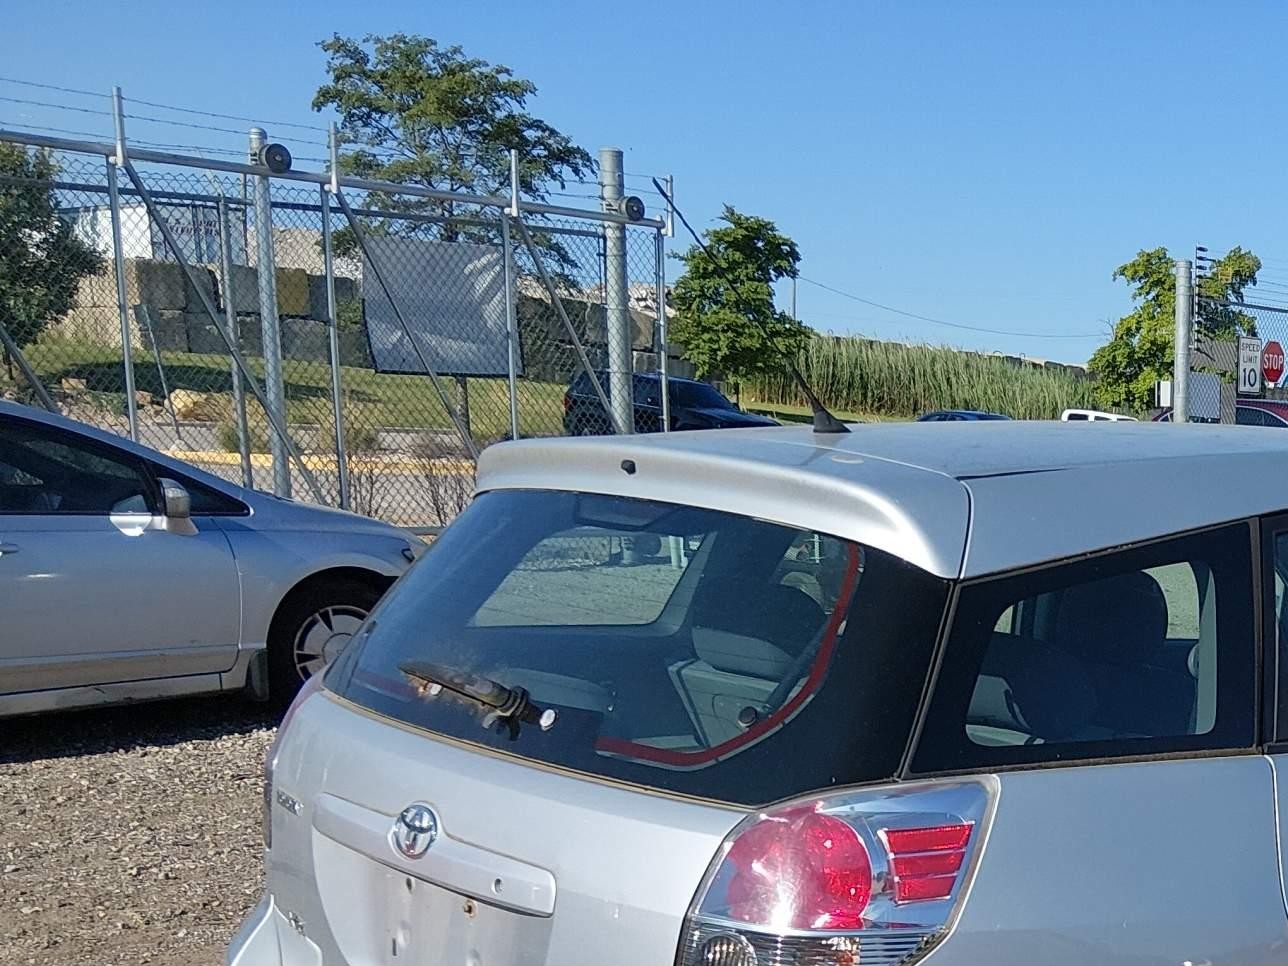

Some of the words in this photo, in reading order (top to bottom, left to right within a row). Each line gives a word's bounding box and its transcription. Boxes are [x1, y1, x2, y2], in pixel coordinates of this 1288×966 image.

[1241, 342, 1260, 352] SPEED
[1243, 354, 1258, 364] LIMIT
[1263, 353, 1283, 371] STOP
[1243, 368, 1257, 387] 10
